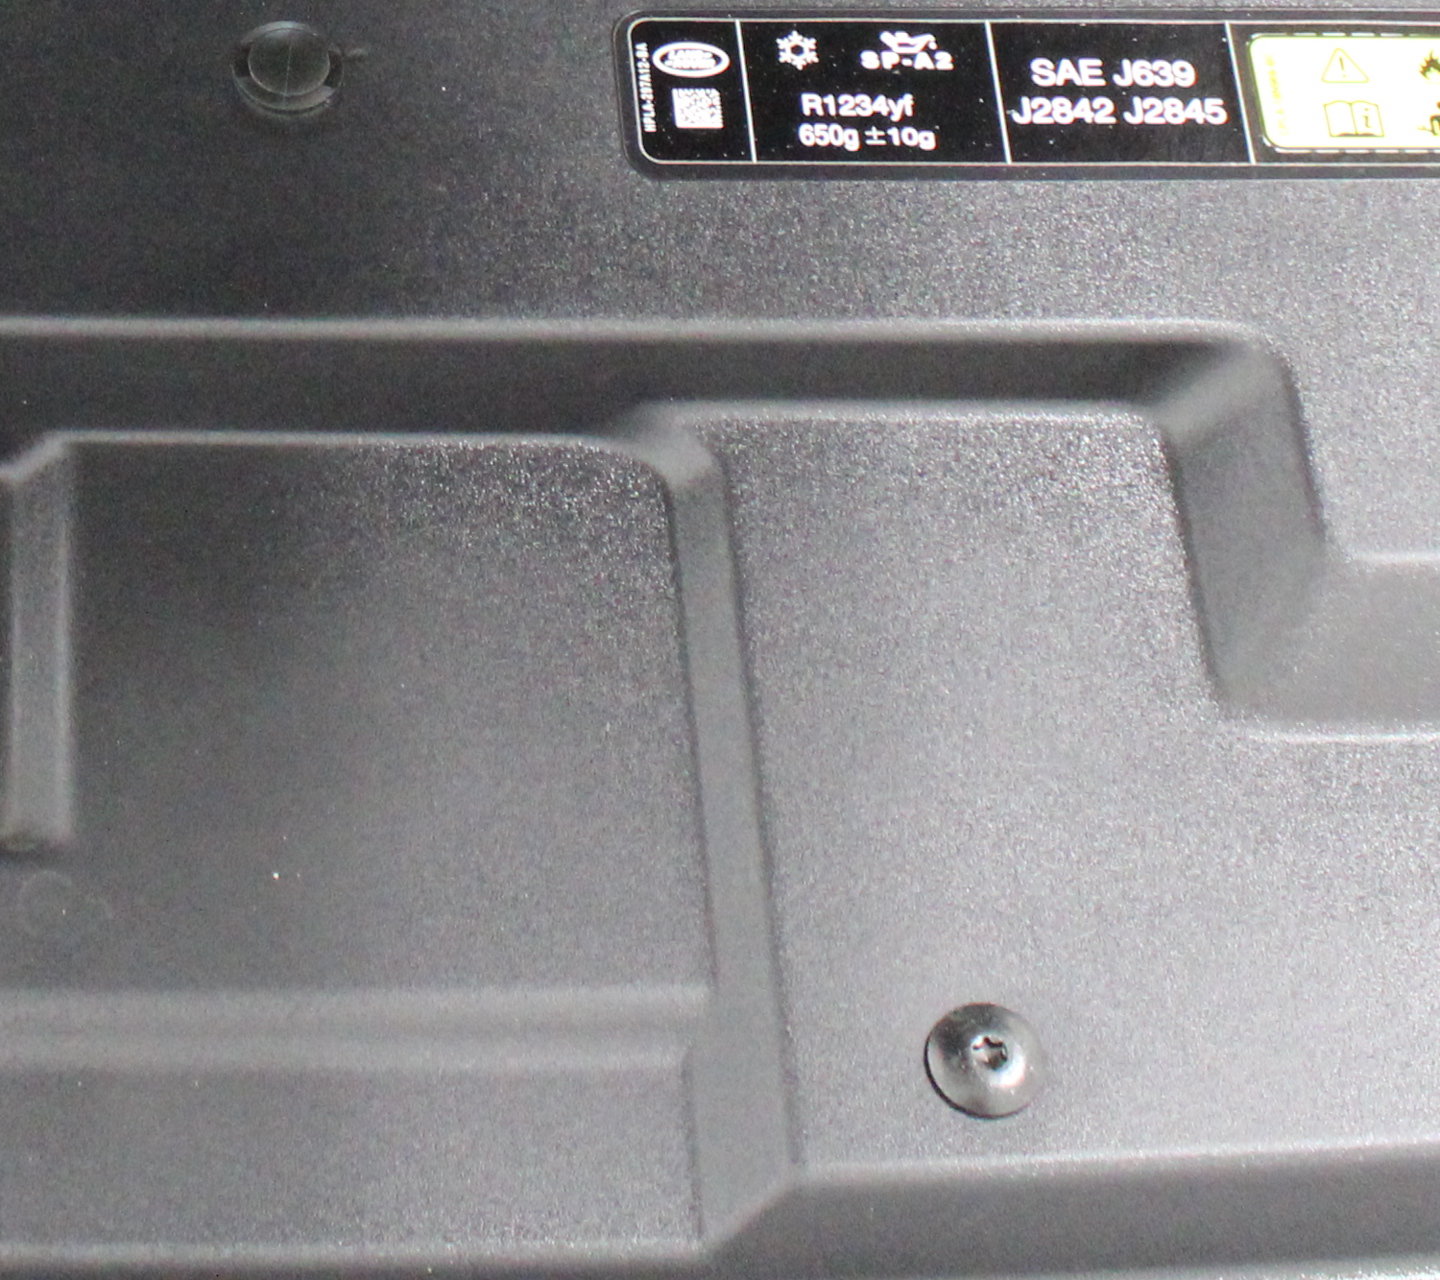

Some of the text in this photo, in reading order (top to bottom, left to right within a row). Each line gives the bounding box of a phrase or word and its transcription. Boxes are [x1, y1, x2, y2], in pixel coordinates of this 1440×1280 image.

[860, 49, 954, 70] SP-A2
[1029, 57, 1197, 88] SAE J639
[800, 92, 916, 122] R1234yf
[1010, 95, 1229, 125] J2842 J2845
[798, 122, 860, 152] 650g
